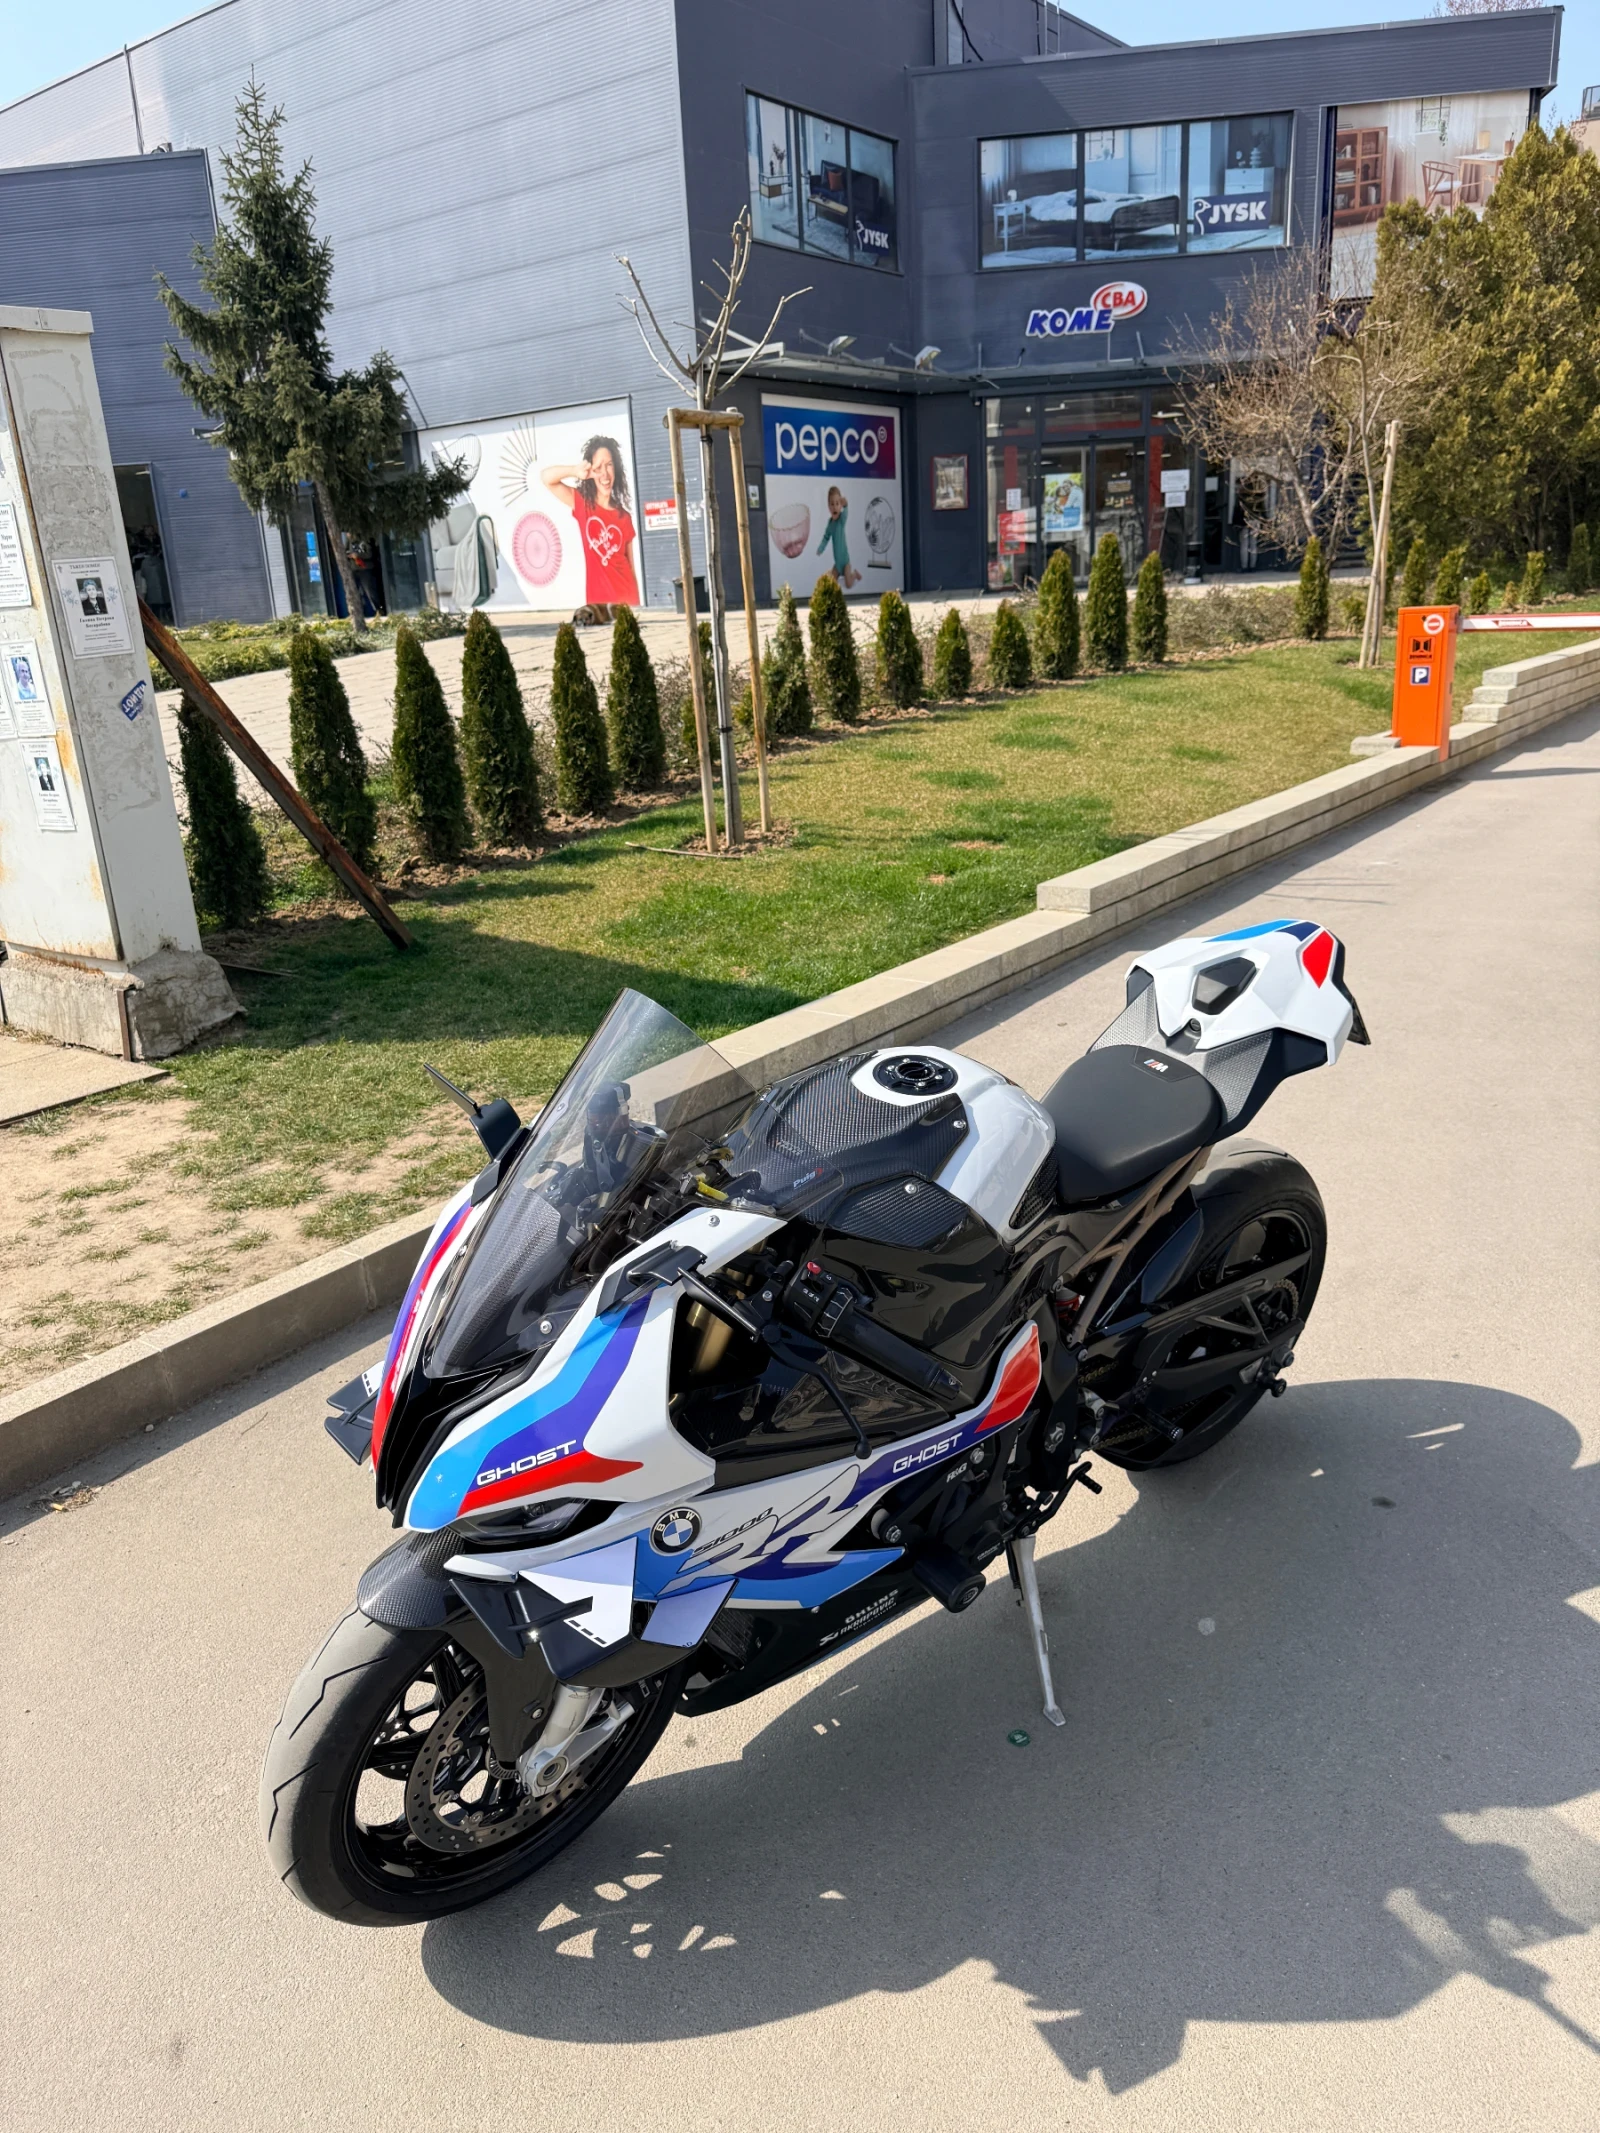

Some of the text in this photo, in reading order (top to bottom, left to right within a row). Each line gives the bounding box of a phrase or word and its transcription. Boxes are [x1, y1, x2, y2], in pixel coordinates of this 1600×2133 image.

[1208, 200, 1268, 225] JYSK
[863, 228, 889, 250] JYSK
[1101, 290, 1136, 309] CBA
[1027, 308, 1114, 336] KOME
[775, 422, 879, 472] pepco
[1414, 668, 1428, 683] P
[793, 1170, 816, 1188] Puig
[476, 1439, 577, 1486] GHOST
[892, 1432, 963, 1474] GHOST
[655, 1511, 696, 1532] BMW
